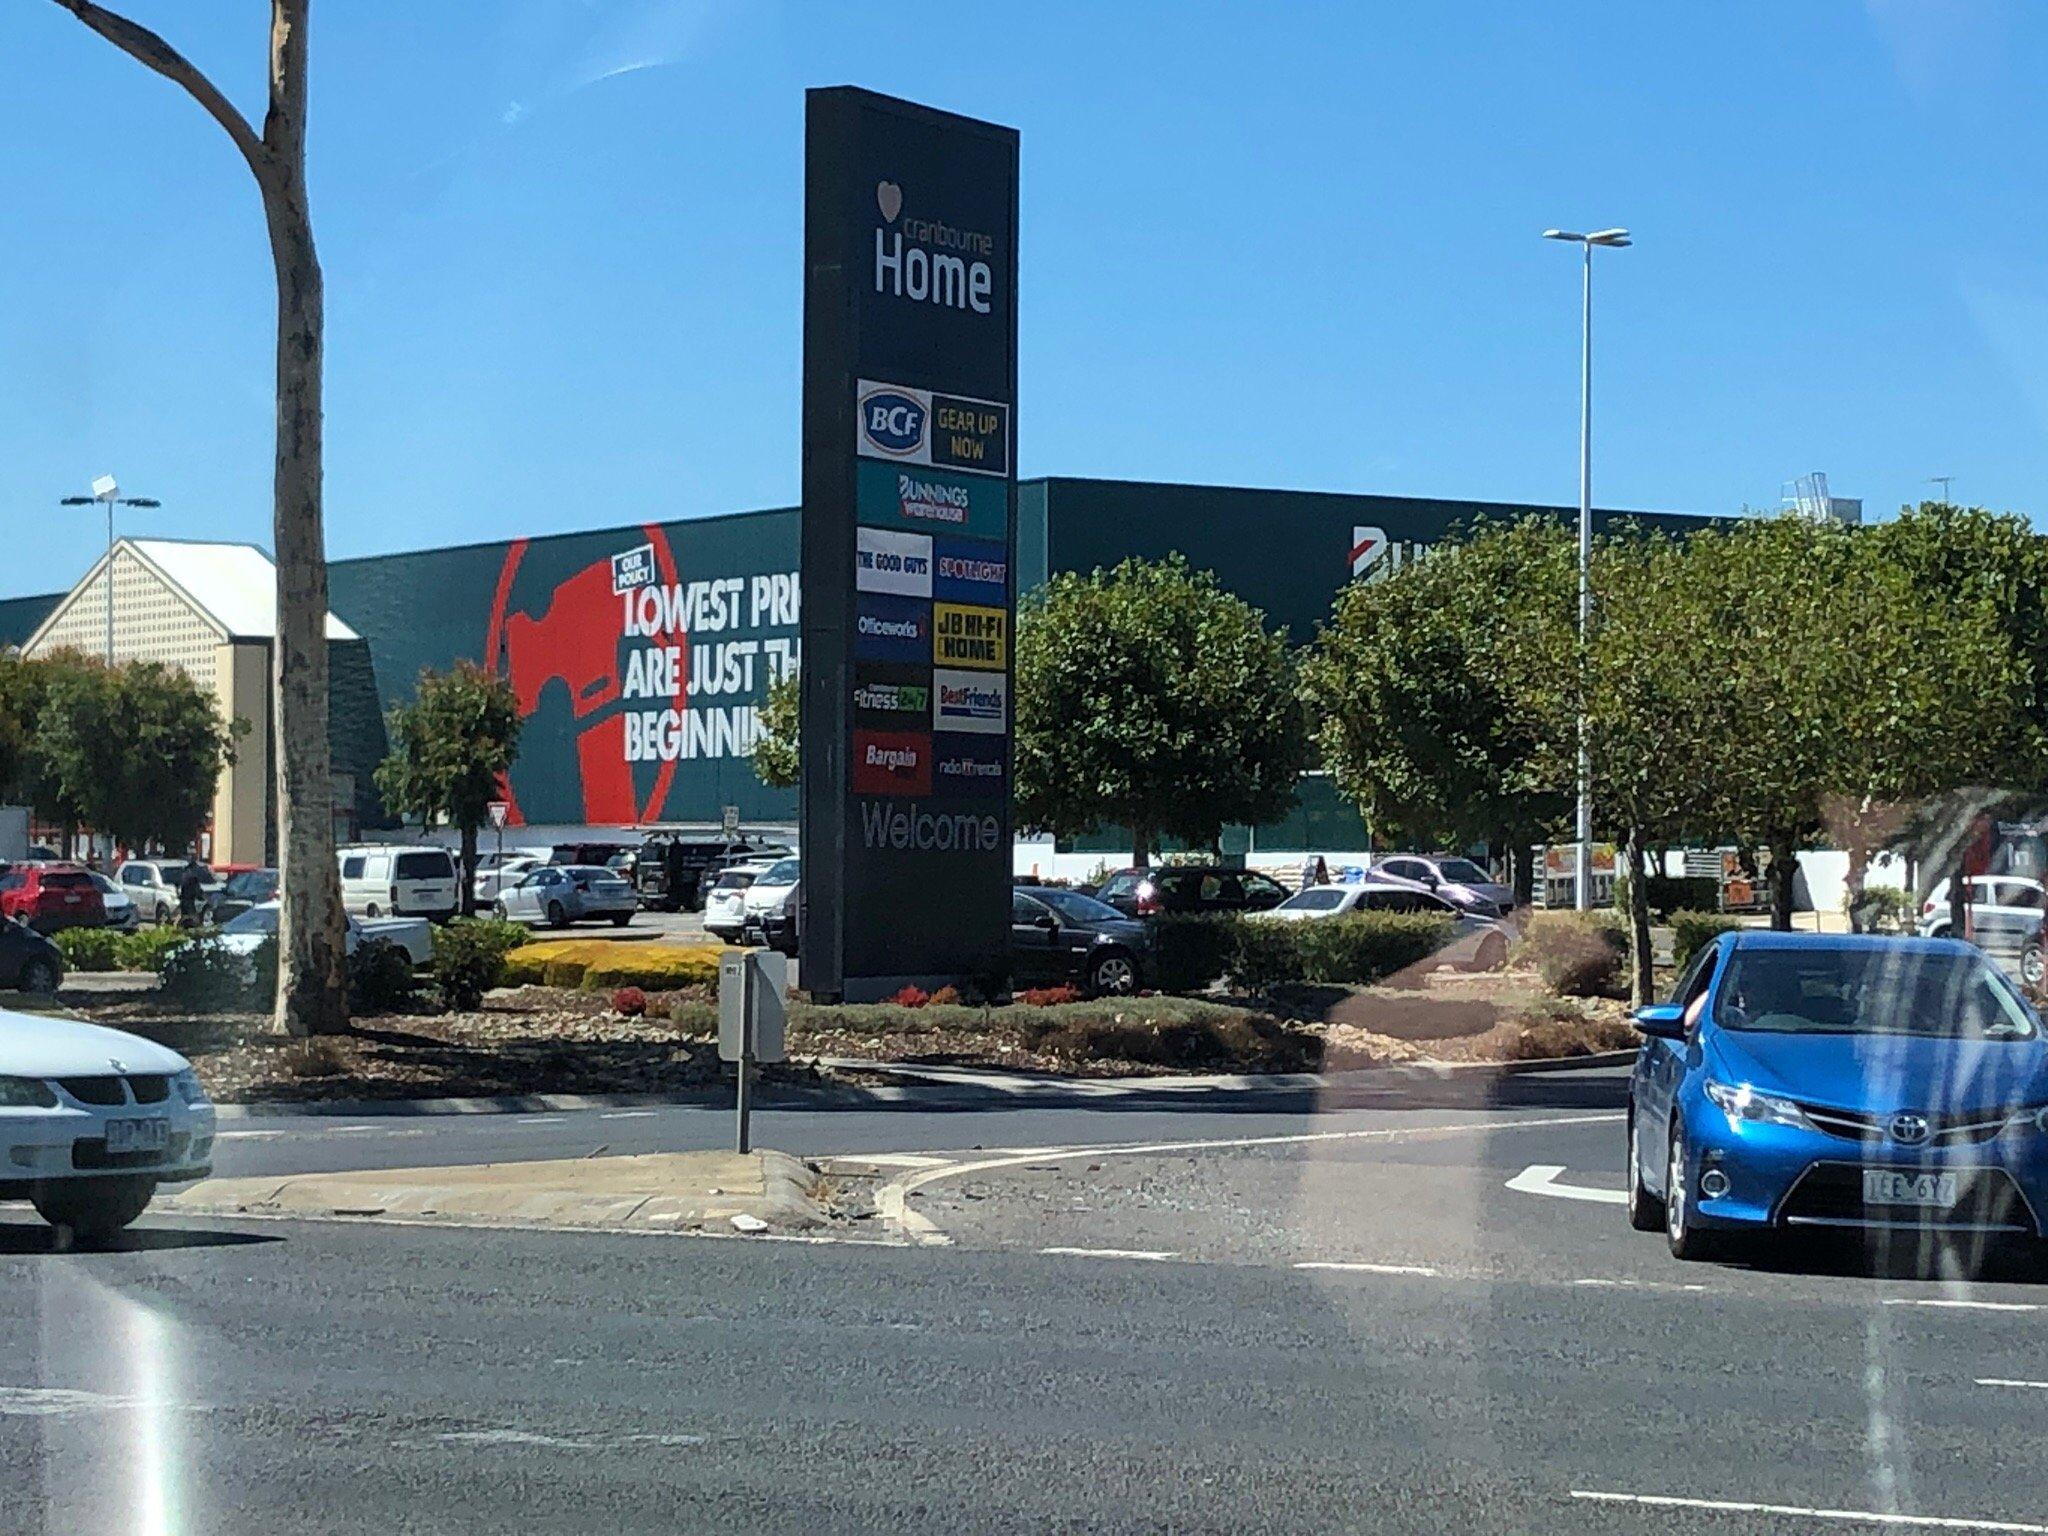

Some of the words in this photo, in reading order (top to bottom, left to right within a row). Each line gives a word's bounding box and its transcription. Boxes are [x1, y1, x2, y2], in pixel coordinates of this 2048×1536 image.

[904, 217, 992, 255] cranbourne
[876, 227, 991, 314] Home
[871, 406, 918, 436] BCF
[938, 408, 974, 433] GEAR
[978, 414, 998, 435] UP
[951, 435, 984, 460] NOW
[618, 566, 650, 588] POLICY
[876, 553, 901, 572] GOOD
[904, 556, 927, 575] GUYS
[624, 577, 744, 637] LOWEST
[751, 571, 801, 627] PRI
[858, 616, 918, 638] Officeworks
[937, 612, 963, 635] JB
[943, 638, 996, 661] HOME
[622, 646, 681, 699] ARE
[686, 640, 759, 696] JUST
[865, 744, 917, 772] Bargain
[861, 801, 1000, 850] Welcome
